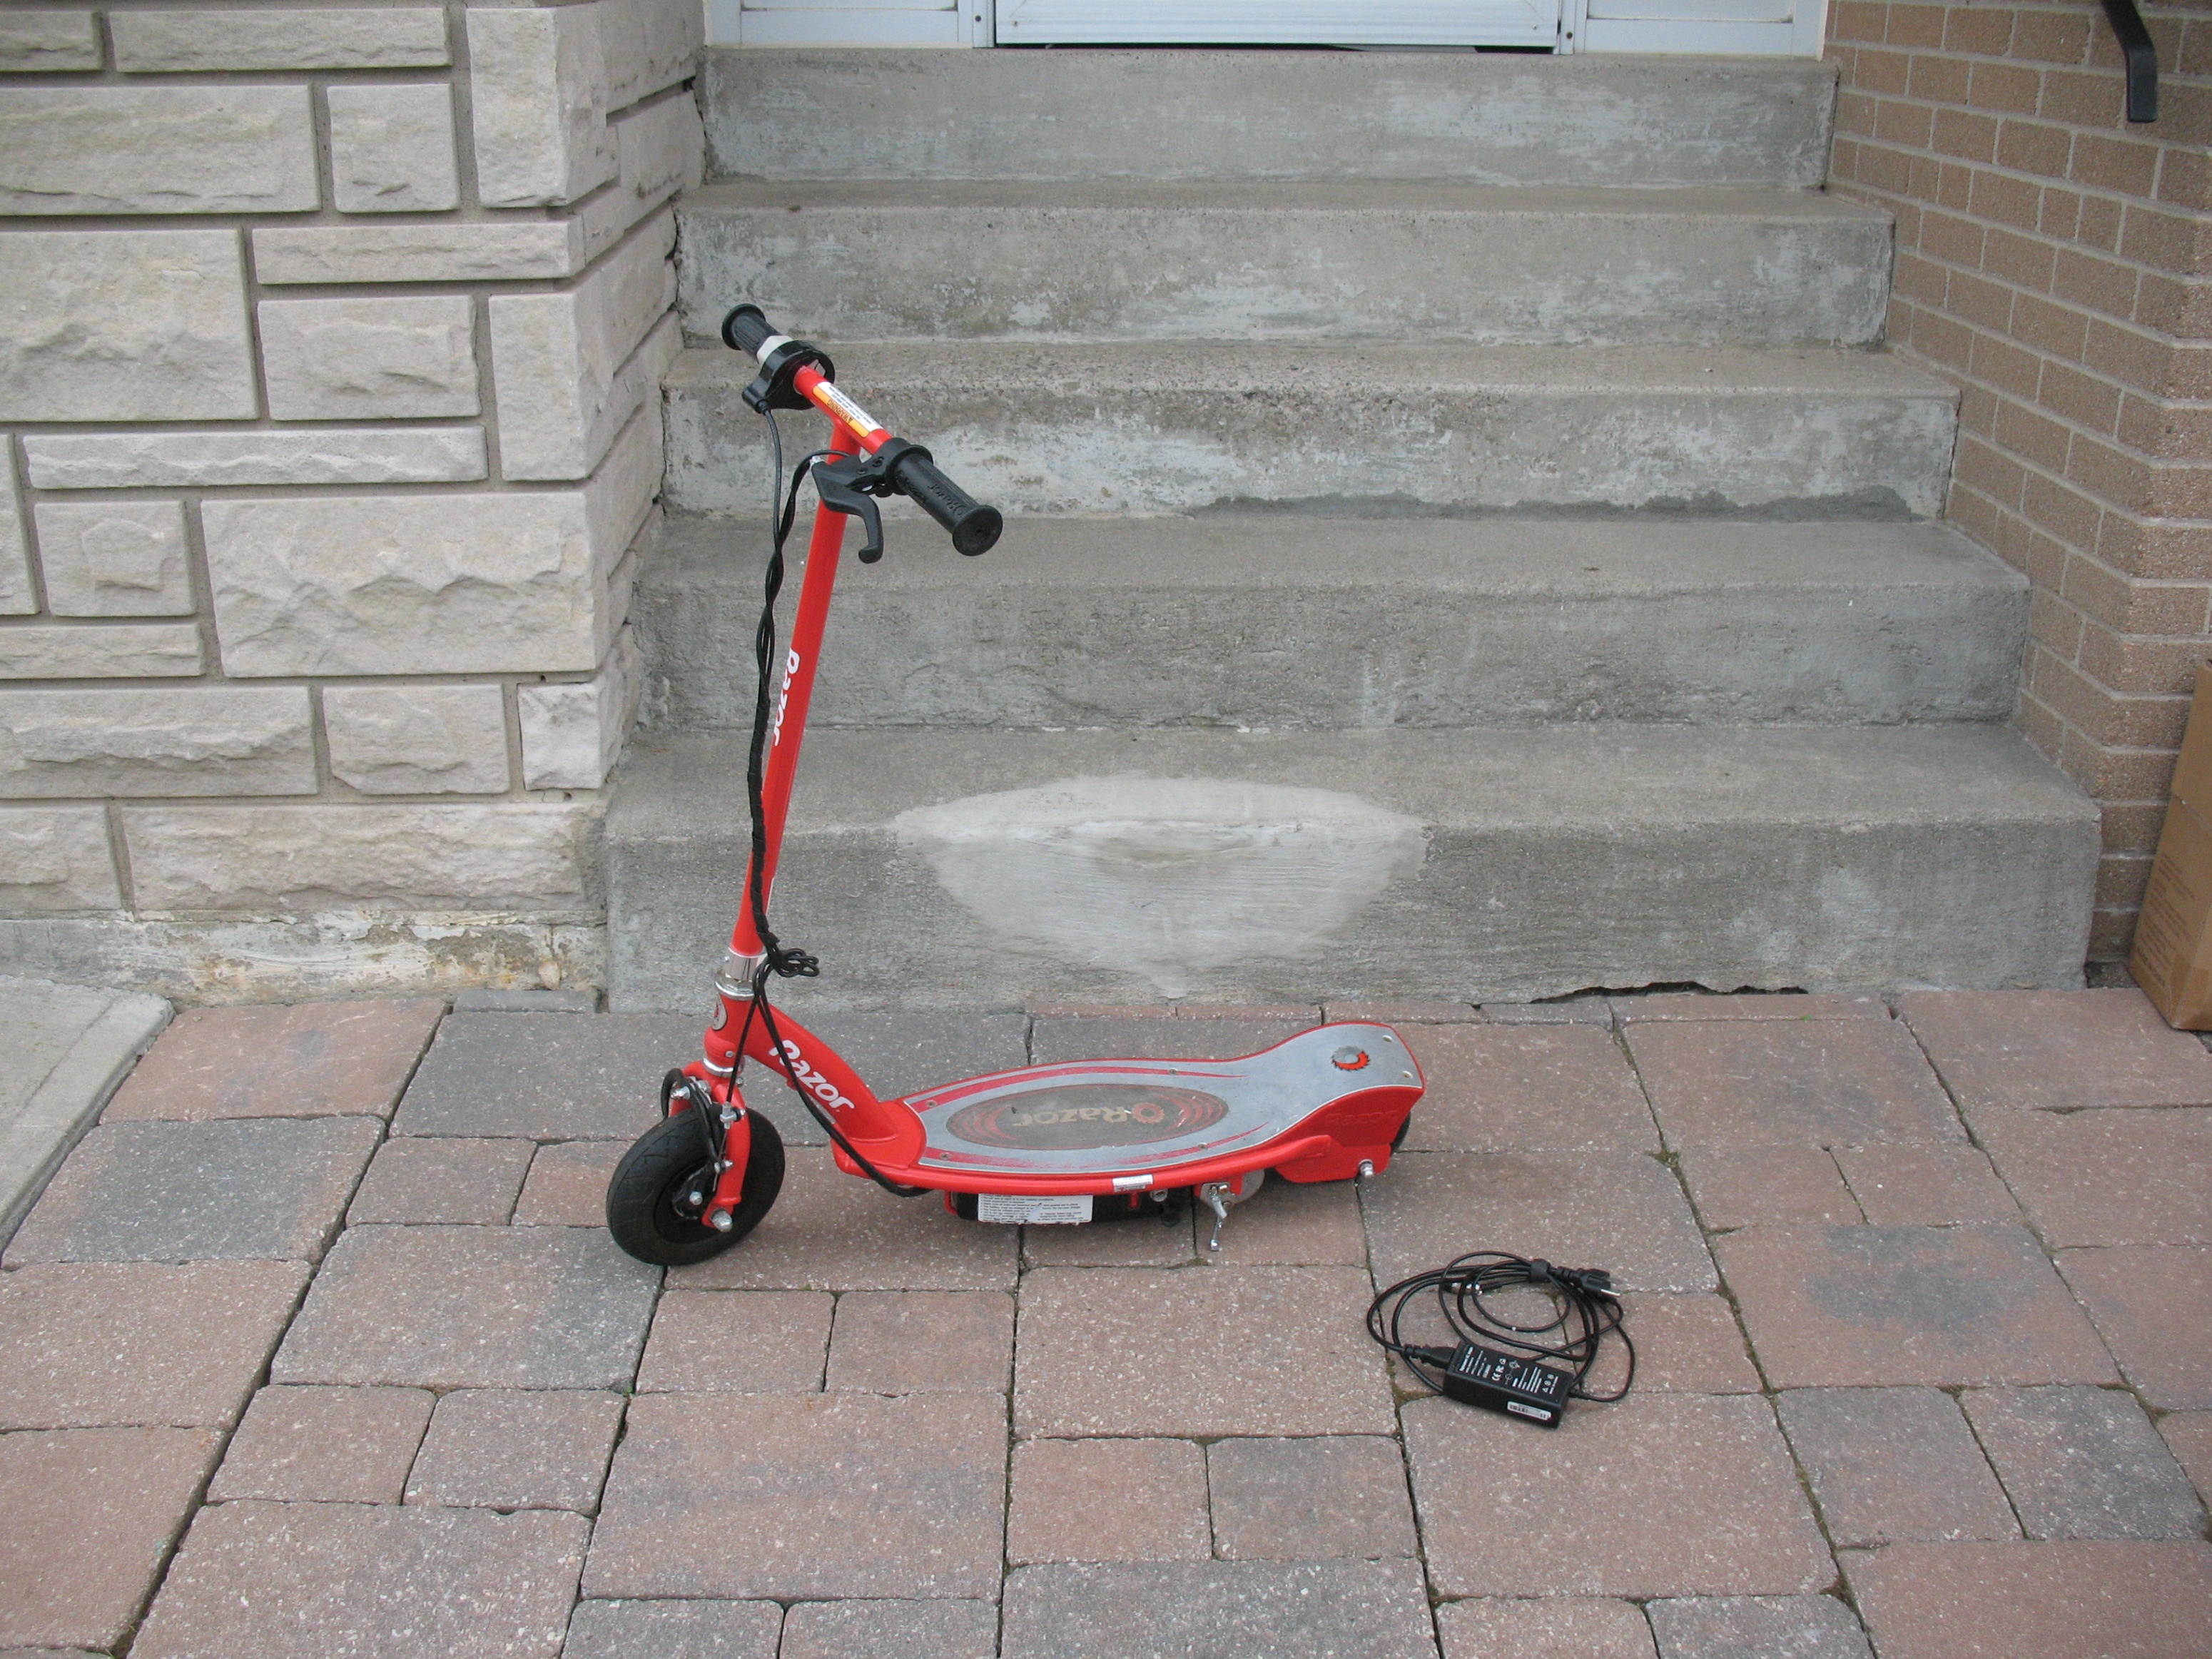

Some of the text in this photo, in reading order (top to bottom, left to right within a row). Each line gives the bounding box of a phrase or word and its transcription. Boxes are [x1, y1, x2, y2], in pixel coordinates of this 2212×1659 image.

[827, 399, 849, 422] WARNING
[768, 1039, 855, 1109] Razor
[1013, 1106, 1129, 1127] Razor
